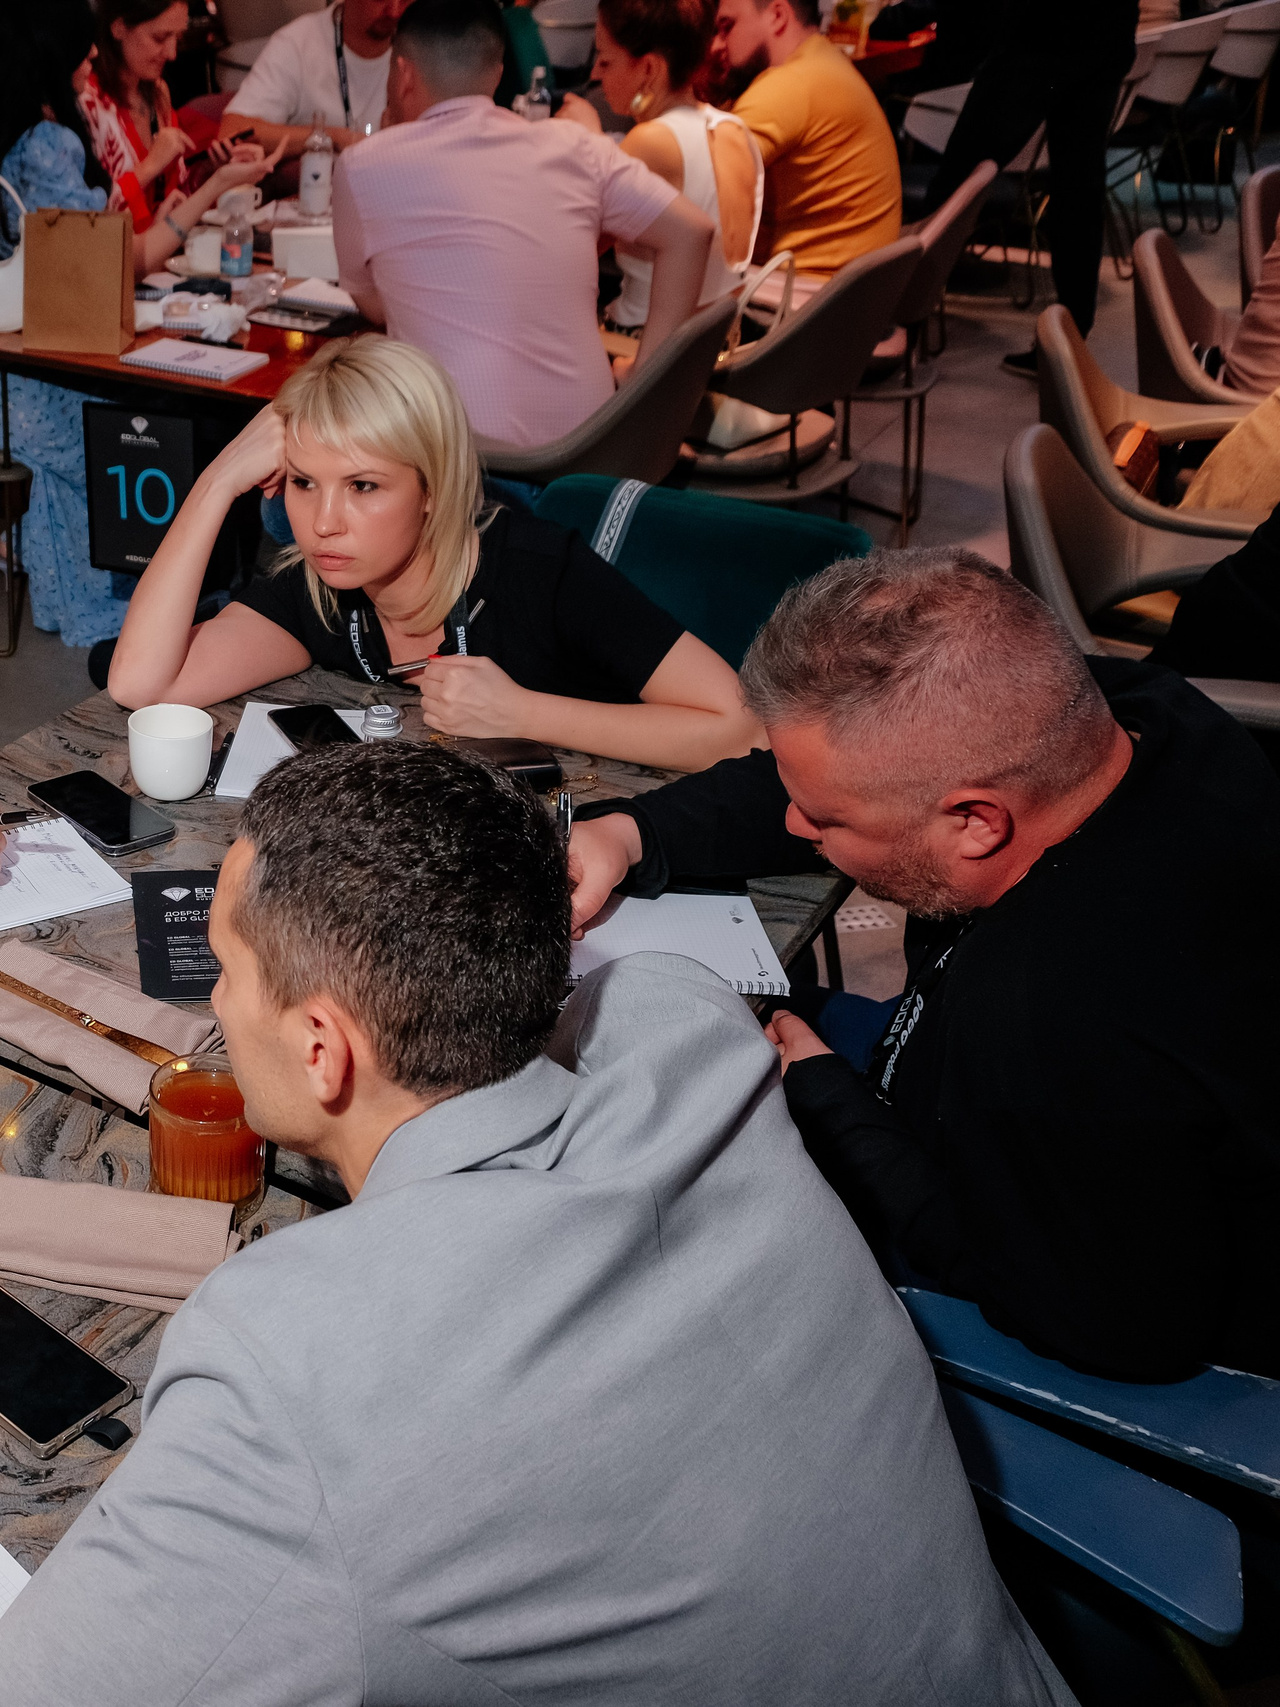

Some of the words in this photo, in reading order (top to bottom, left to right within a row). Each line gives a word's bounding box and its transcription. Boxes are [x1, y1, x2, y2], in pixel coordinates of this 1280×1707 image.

[107, 464, 175, 526] 10
[125, 554, 152, 563] #EDGLO
[163, 909, 200, 917] ДОБРО
